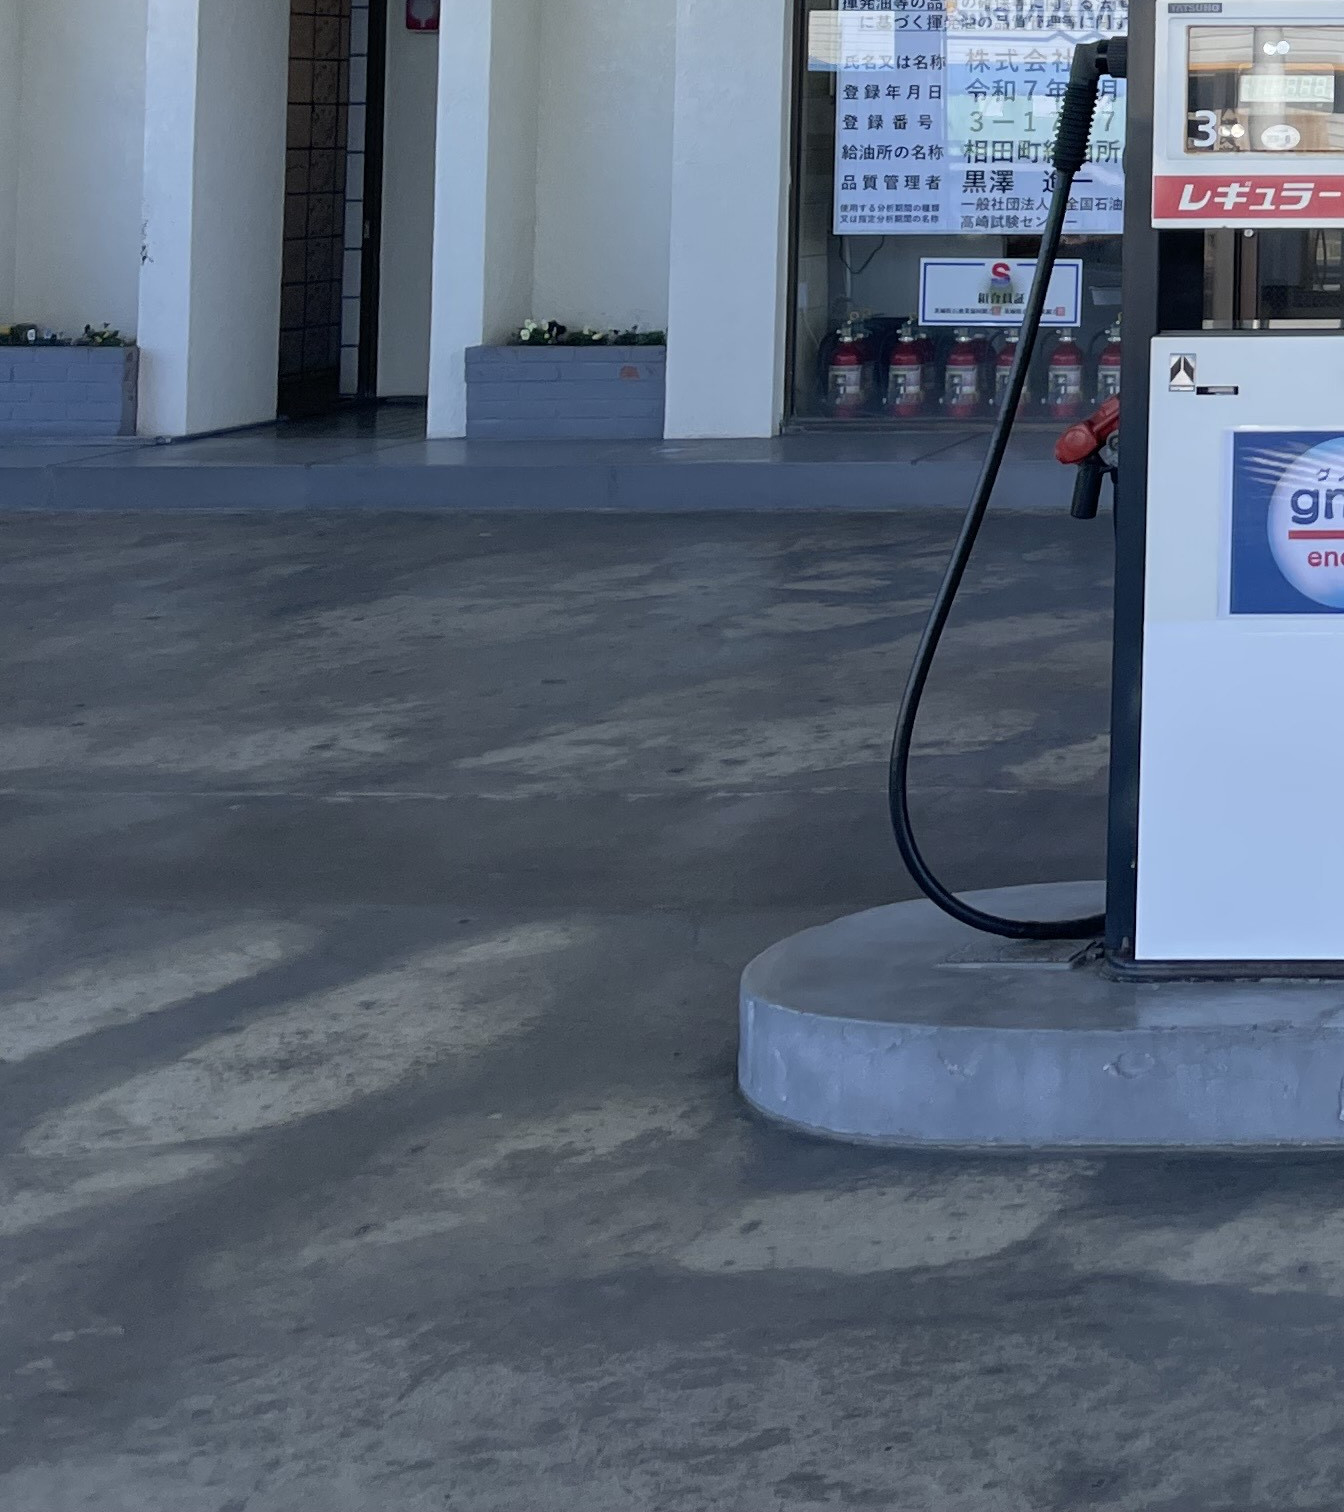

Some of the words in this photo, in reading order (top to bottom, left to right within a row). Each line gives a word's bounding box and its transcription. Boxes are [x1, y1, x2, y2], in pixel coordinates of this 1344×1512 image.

[844, 55, 946, 71] 氏名又は名称
[842, 83, 942, 101] 登録年月日
[965, 79, 1119, 103] 令和7年月
[842, 114, 933, 131] 登録番号
[1193, 109, 1217, 147] 3
[841, 144, 944, 161] 給油所の名称
[964, 139, 1121, 164] 相田町所
[842, 174, 941, 191] 品質管理者
[1177, 181, 1342, 212] レギュラー
[961, 215, 1077, 229] 高崎試験センー
